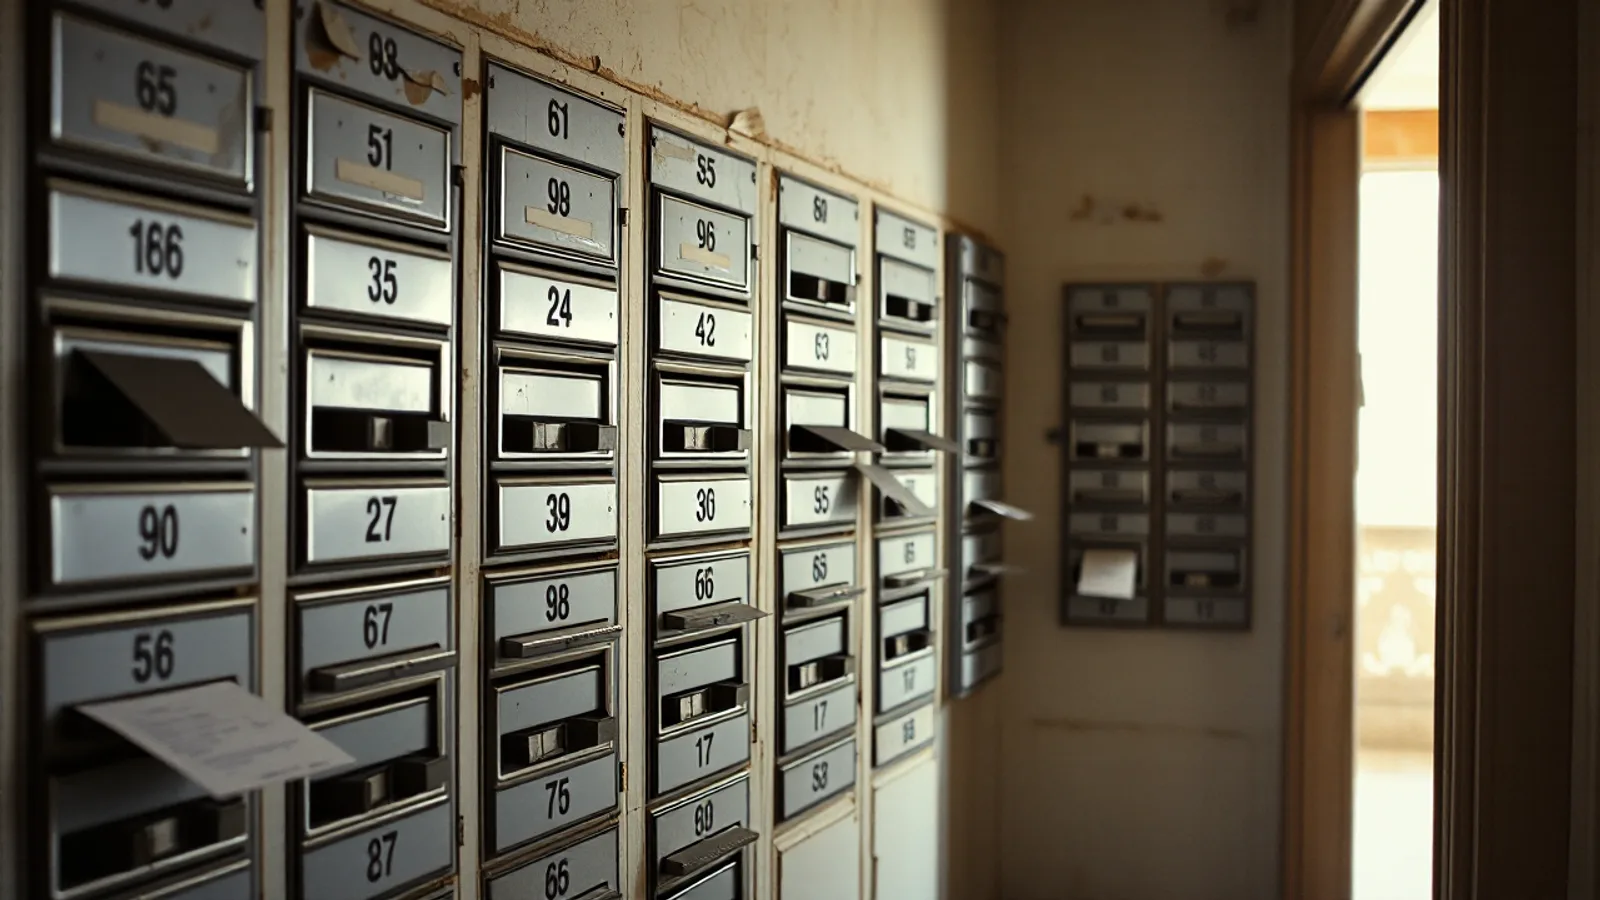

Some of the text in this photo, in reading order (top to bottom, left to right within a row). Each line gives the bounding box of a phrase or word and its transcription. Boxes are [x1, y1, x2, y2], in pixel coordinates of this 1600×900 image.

[135, 60, 177, 116] 65
[548, 99, 569, 139] 61
[367, 124, 392, 171] 51
[547, 177, 570, 217] 98
[129, 219, 184, 279] 166
[696, 218, 716, 252] 96
[367, 256, 398, 305] 35
[546, 285, 572, 328] 24
[695, 312, 716, 347] 42
[138, 504, 179, 561] 90
[365, 496, 397, 543] 27
[546, 493, 570, 533] 39
[546, 583, 570, 622] 98
[363, 603, 393, 649] 67
[132, 630, 175, 683] 56
[814, 701, 827, 731] 17
[695, 732, 714, 768] 17
[367, 831, 398, 882] 87
